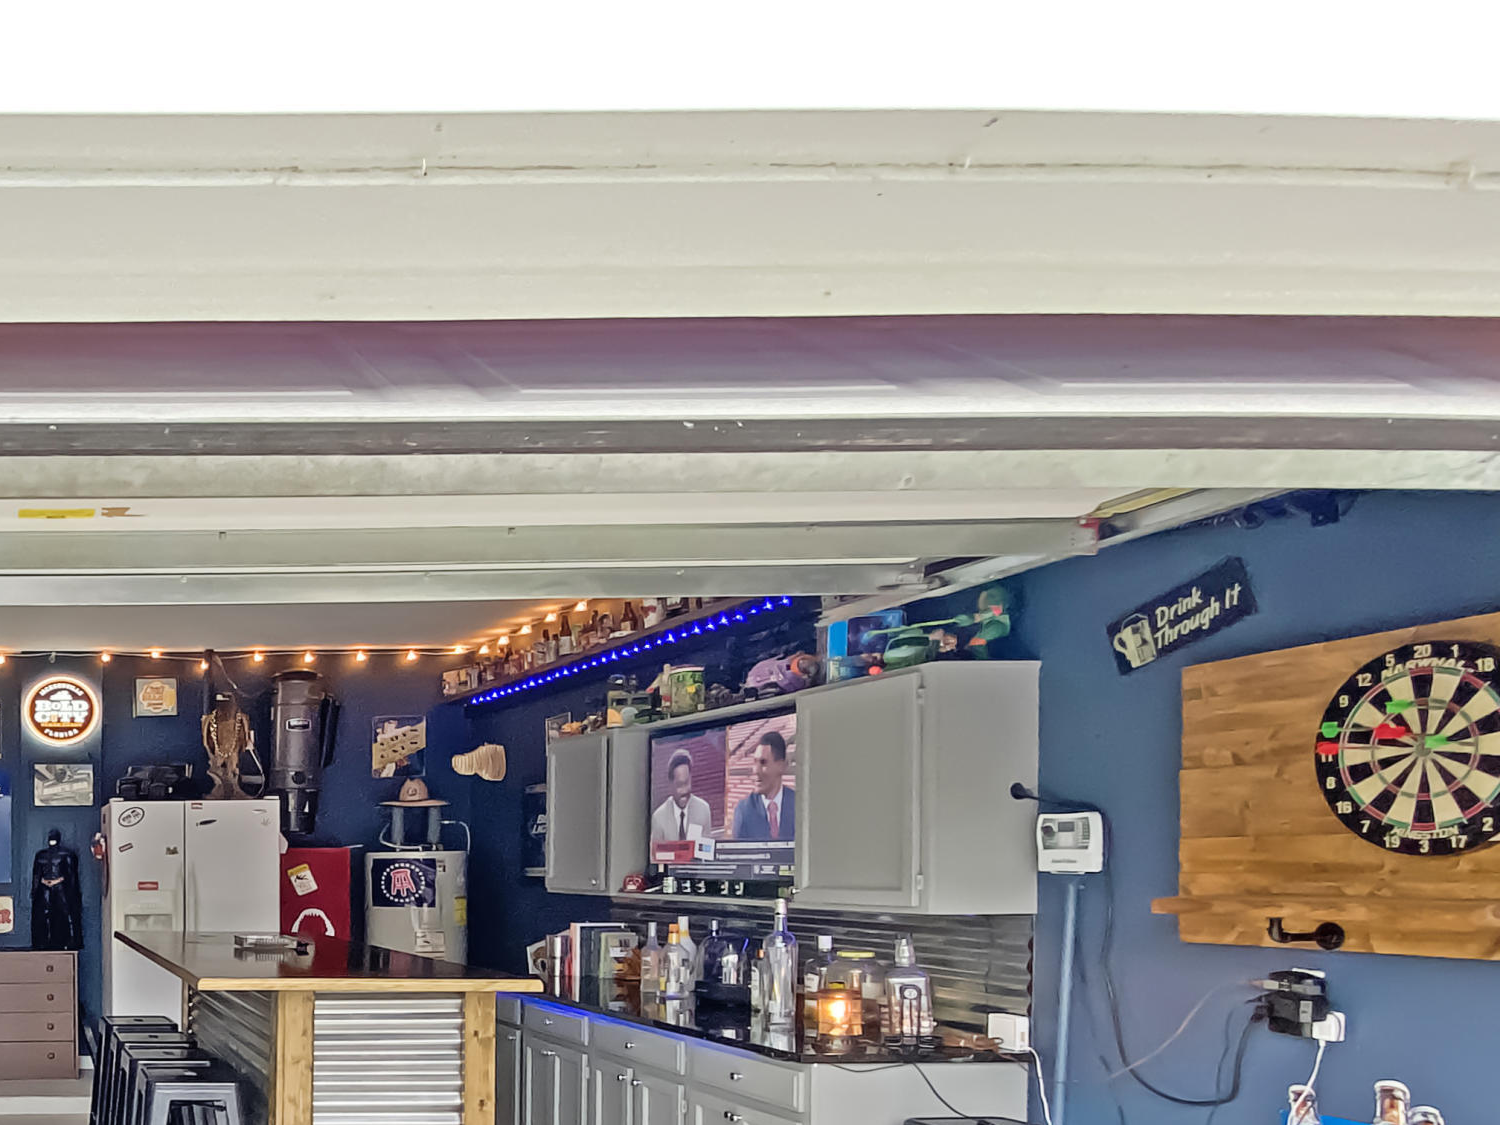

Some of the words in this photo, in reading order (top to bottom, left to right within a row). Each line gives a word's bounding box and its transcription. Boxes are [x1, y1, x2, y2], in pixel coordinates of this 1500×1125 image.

[1155, 586, 1203, 628] Drink
[1154, 596, 1221, 649] Through
[1225, 582, 1242, 609] It
[1413, 644, 1432, 658] 20
[1451, 644, 1460, 658] 1
[1385, 654, 1396, 667] 5
[1475, 657, 1496, 672] 18
[1356, 673, 1373, 687] 12
[1339, 695, 1350, 708] 9
[34, 711, 88, 723] CITY
[1335, 801, 1353, 814] 16
[1360, 820, 1372, 833] 7
[1481, 817, 1494, 832] 2
[1383, 836, 1401, 848] 19
[1419, 840, 1430, 853] 3
[1450, 835, 1468, 848] 17
